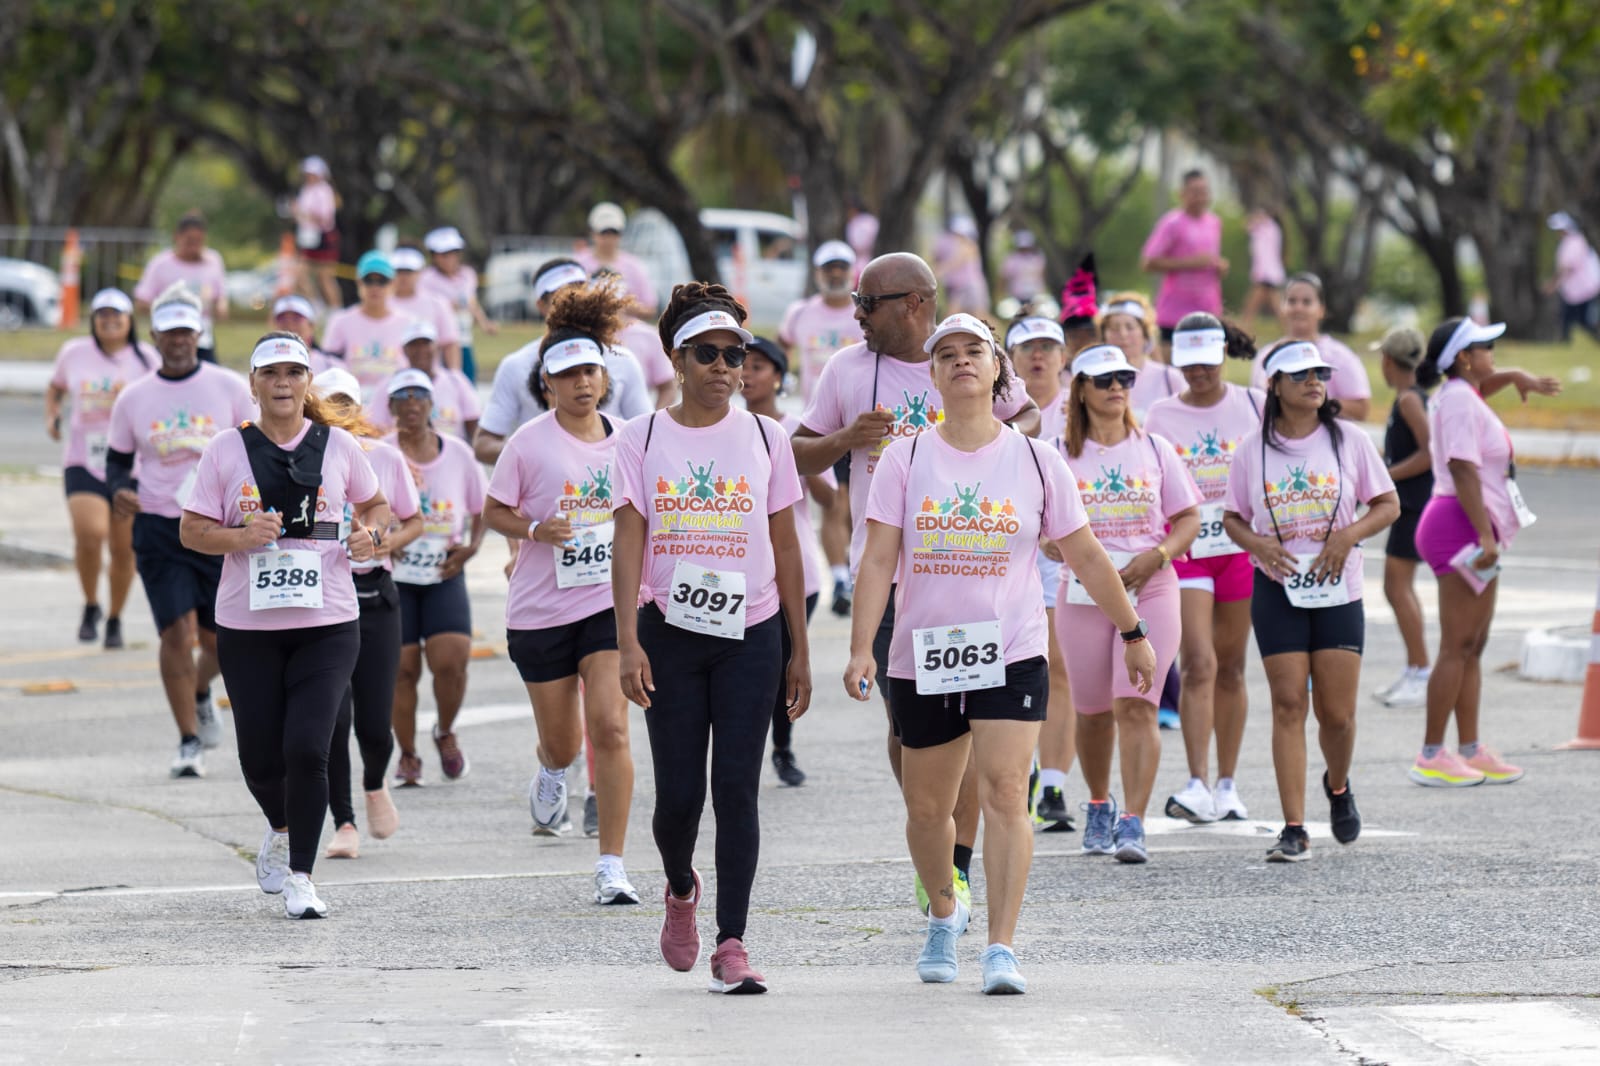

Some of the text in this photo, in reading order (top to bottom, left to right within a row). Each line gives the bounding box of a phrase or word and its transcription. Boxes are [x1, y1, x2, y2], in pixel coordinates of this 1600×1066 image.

[560, 498, 612, 511] EDUCA
[654, 493, 753, 516] EDUCAÇÃO
[1082, 488, 1156, 506] DUCAÇÃO
[662, 513, 743, 529] EM MOVIMENTO
[916, 513, 1019, 536] EDUCAÇÃO
[652, 533, 685, 542] CORRIDA
[694, 534, 748, 544] CAMINHADA
[923, 533, 939, 547] EM
[669, 544, 746, 559] EDUCAÇÃO
[913, 553, 950, 561] CORRIDA
[959, 554, 1010, 563] CAMINHADA
[256, 568, 319, 589] 5388
[913, 561, 1008, 579] DA EDUCAÇÃO
[673, 583, 745, 615] 3097
[923, 642, 999, 671] 5063
